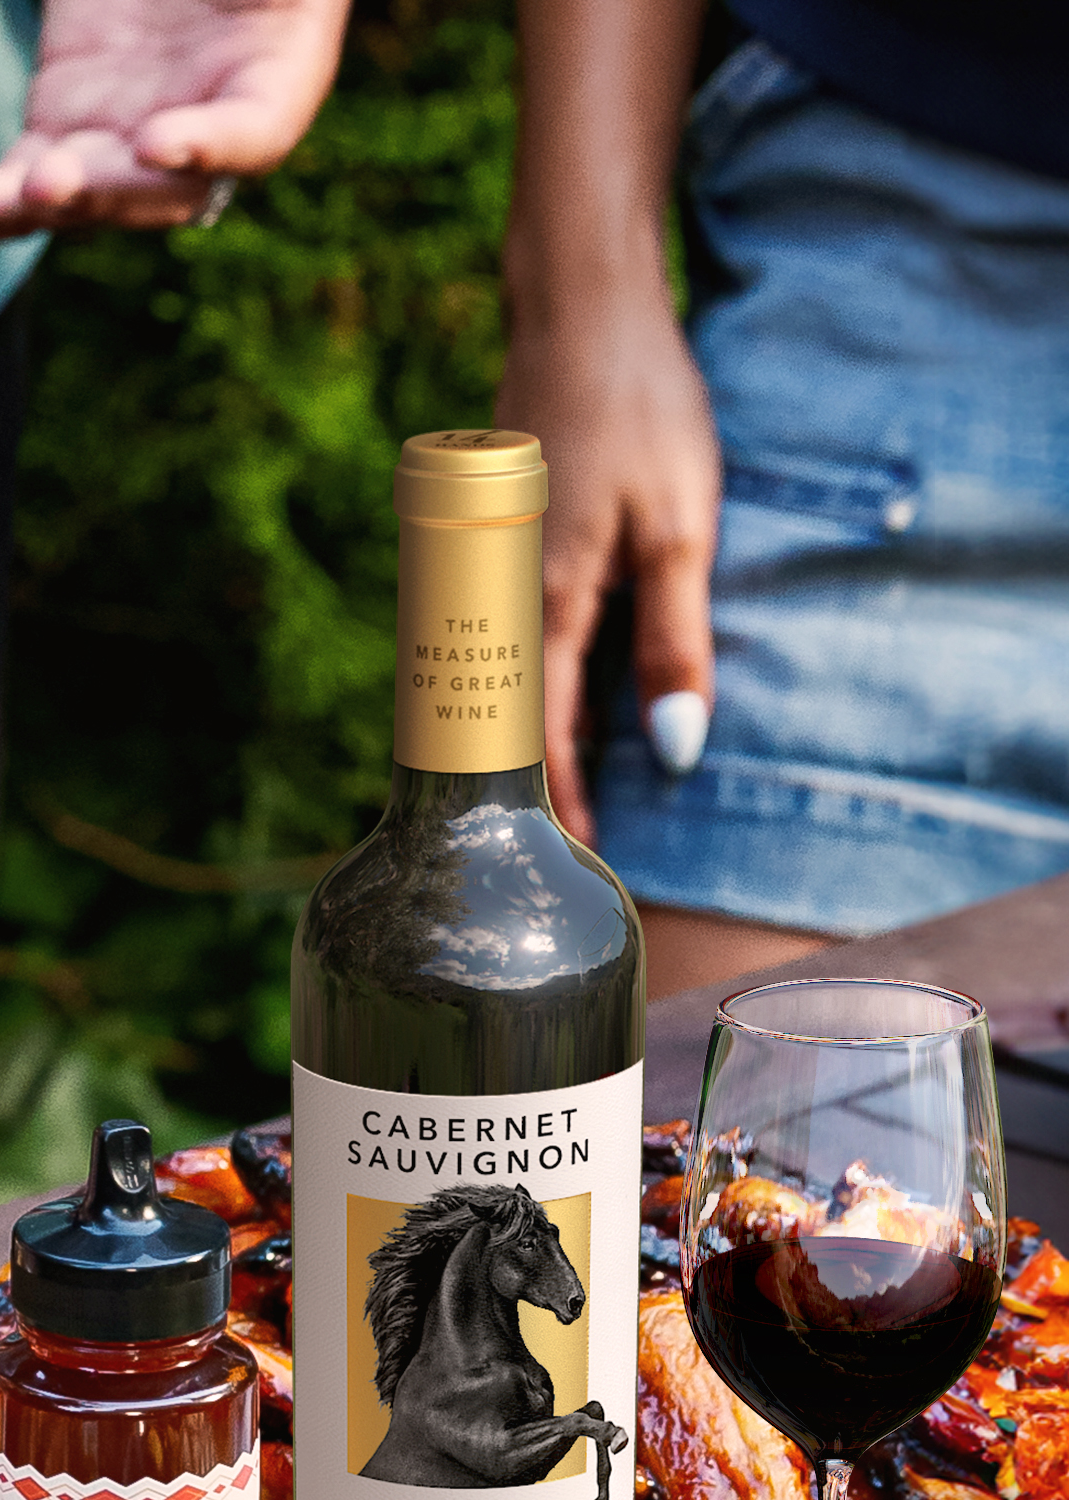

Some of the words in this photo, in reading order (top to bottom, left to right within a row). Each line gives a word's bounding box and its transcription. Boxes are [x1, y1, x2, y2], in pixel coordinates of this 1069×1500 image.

[445, 619, 488, 633] THE
[416, 645, 520, 662] MEASURE
[413, 674, 437, 689] OF
[450, 673, 523, 691] GREAT
[436, 705, 498, 720] WINE
[362, 1108, 579, 1142] CABERNET
[347, 1139, 590, 1175] SAUVIGNON
